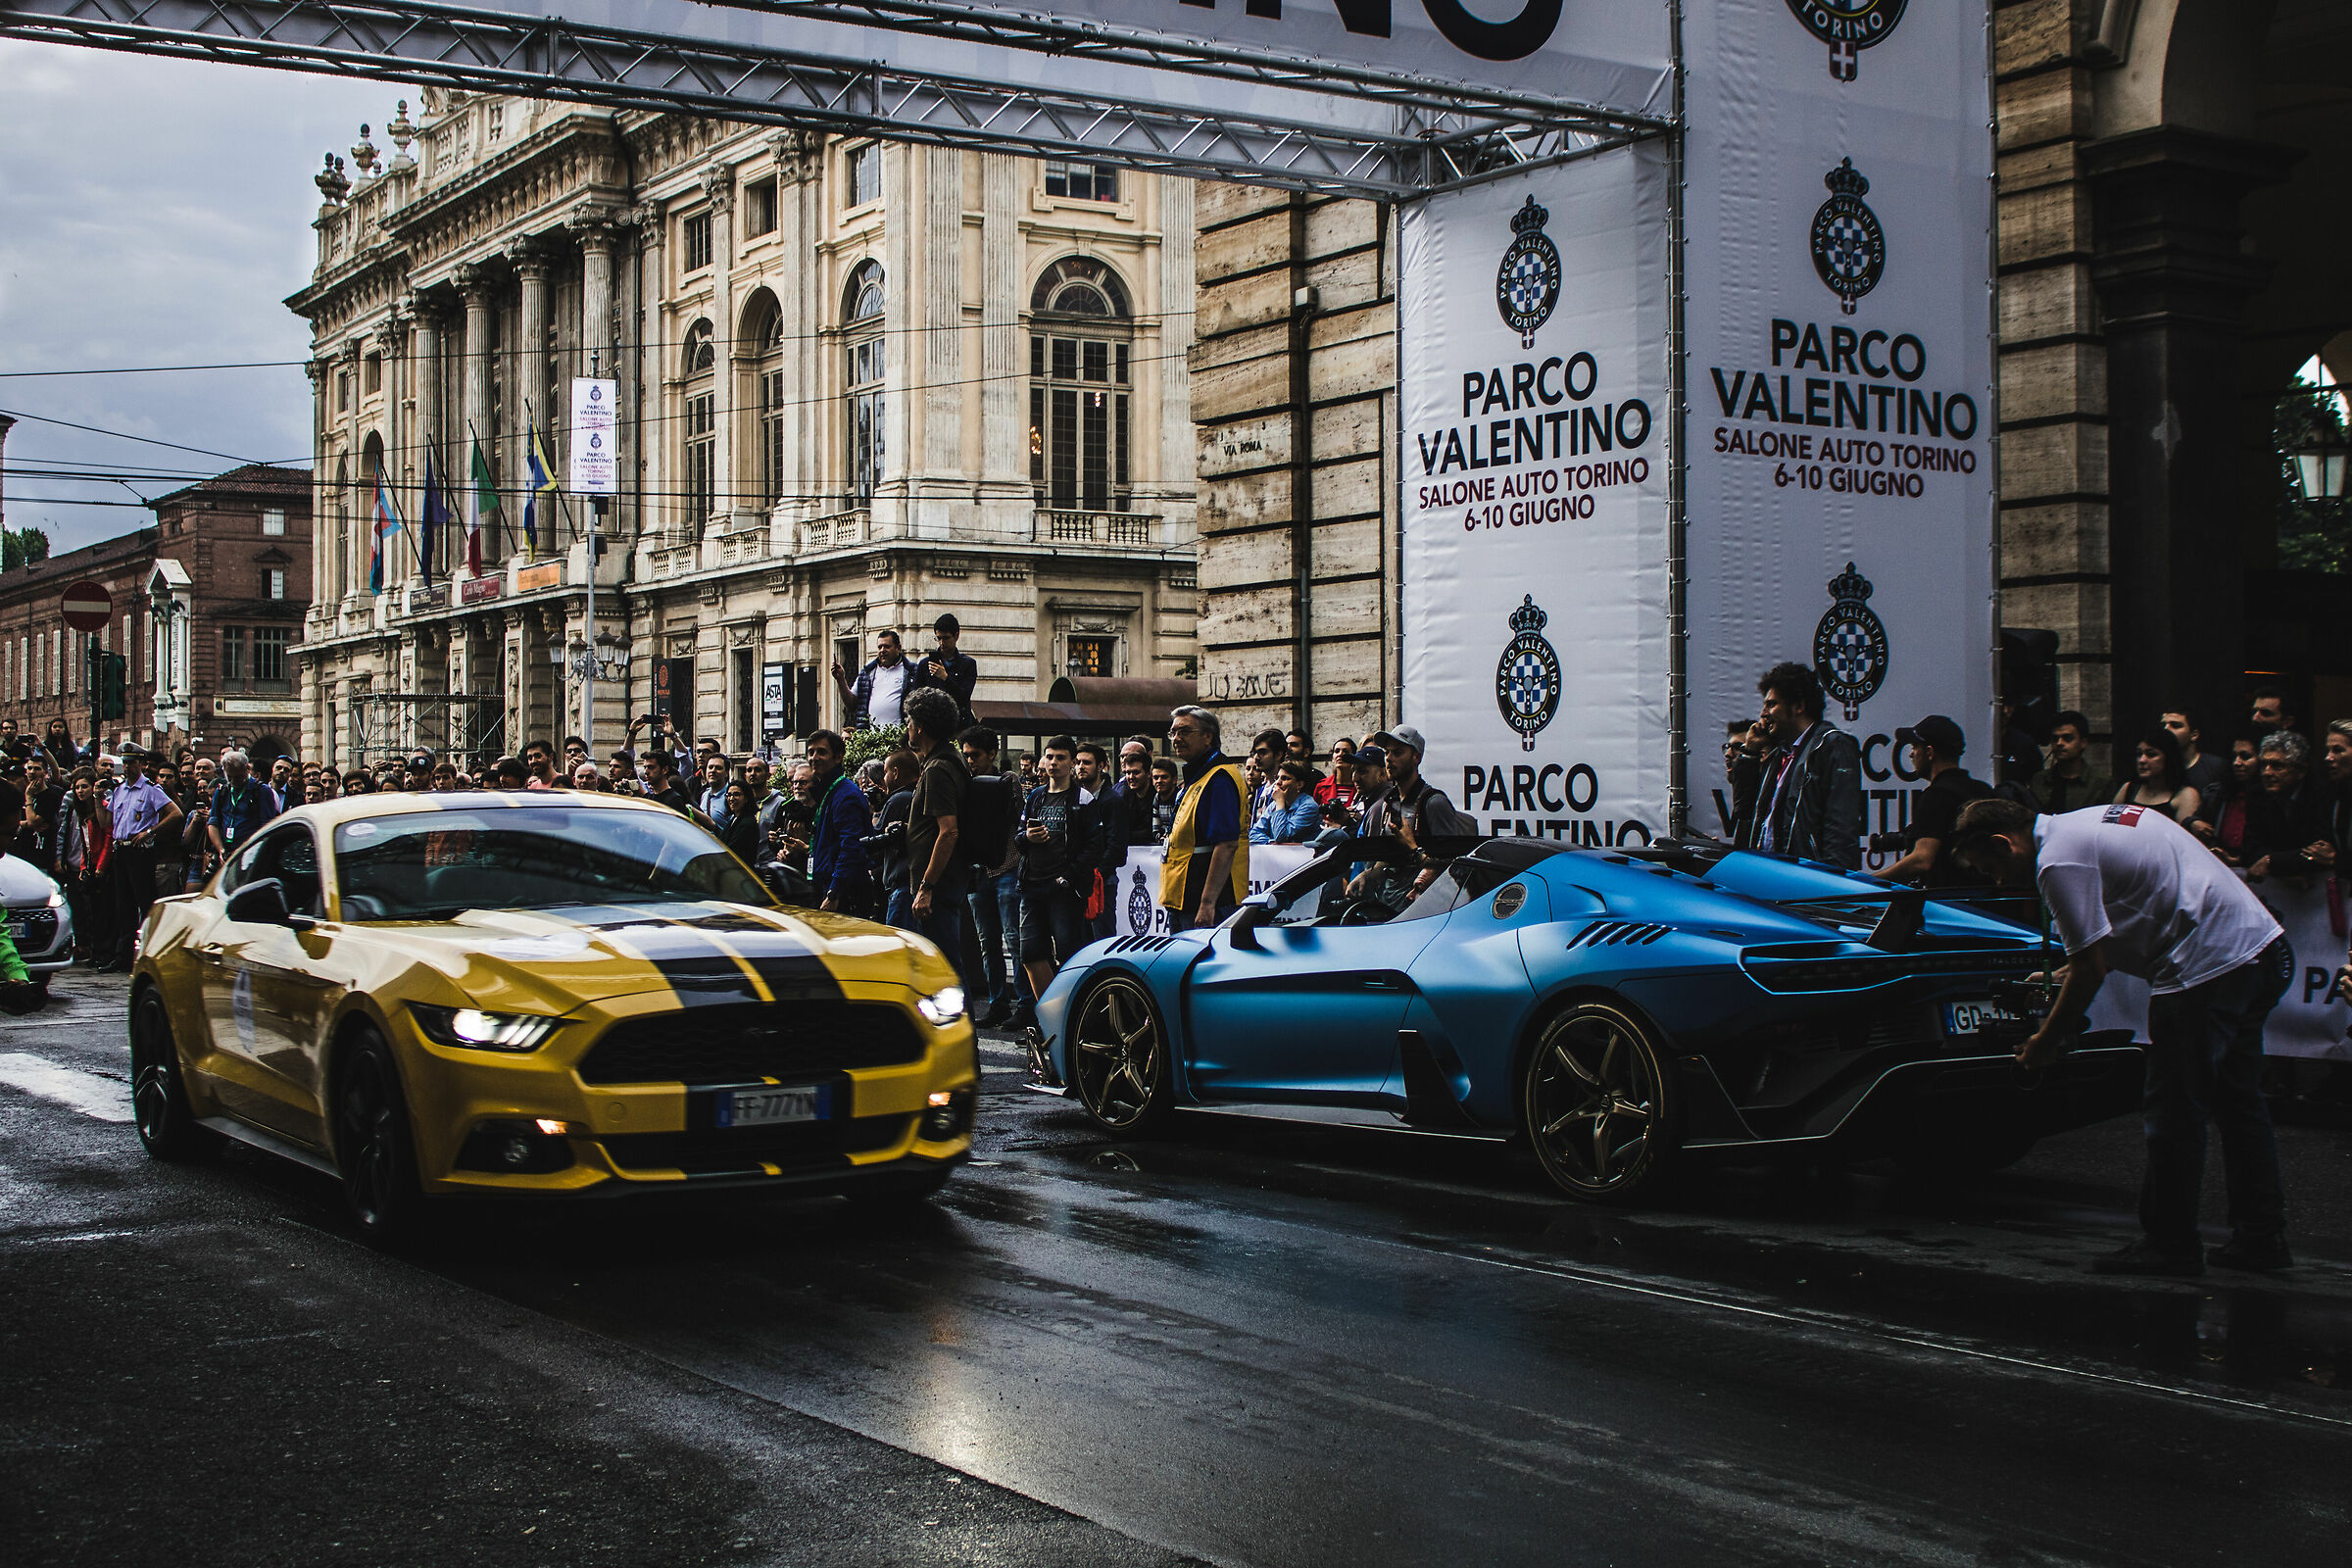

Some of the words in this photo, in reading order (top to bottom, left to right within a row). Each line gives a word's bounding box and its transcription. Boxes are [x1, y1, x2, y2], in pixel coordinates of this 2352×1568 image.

[1801, 0, 1884, 39] TORINO
[1815, 209, 1835, 255] PARCO
[1836, 202, 1882, 265] VALENTINO
[1499, 251, 1518, 299] PARCO
[1518, 238, 1559, 291] VALENTINO
[1826, 271, 1872, 294] TORINO
[1508, 306, 1549, 328] TORINO
[1771, 318, 1928, 382] PARCO
[1463, 351, 1598, 418] PARCO
[1710, 367, 1979, 441] VALENTINO
[1223, 445, 1237, 457] VIA
[1240, 440, 1262, 455] ROMA
[1417, 398, 1653, 476] VALENTINO
[1713, 426, 1812, 461] SALONE
[1819, 437, 1886, 466] AUTO
[1889, 443, 1977, 474] TORINO
[1419, 477, 1495, 510] SALONE
[1500, 468, 1559, 500] AUTO
[1563, 457, 1650, 489] TORINO
[1773, 463, 1823, 490] 6-10
[1829, 467, 1925, 499] GIUGNO
[1464, 505, 1504, 532] 6-10
[1509, 493, 1595, 527] GIUGNO
[1818, 616, 1836, 664] PARCO
[1838, 608, 1885, 667] VALENTINO
[765, 684, 782, 699] ASTA
[1498, 649, 1516, 697] PARCO
[1517, 639, 1558, 697] VALENTINO
[1829, 678, 1874, 700] TORINO
[1508, 710, 1548, 731] TORINO
[1463, 763, 1598, 813] PARCO
